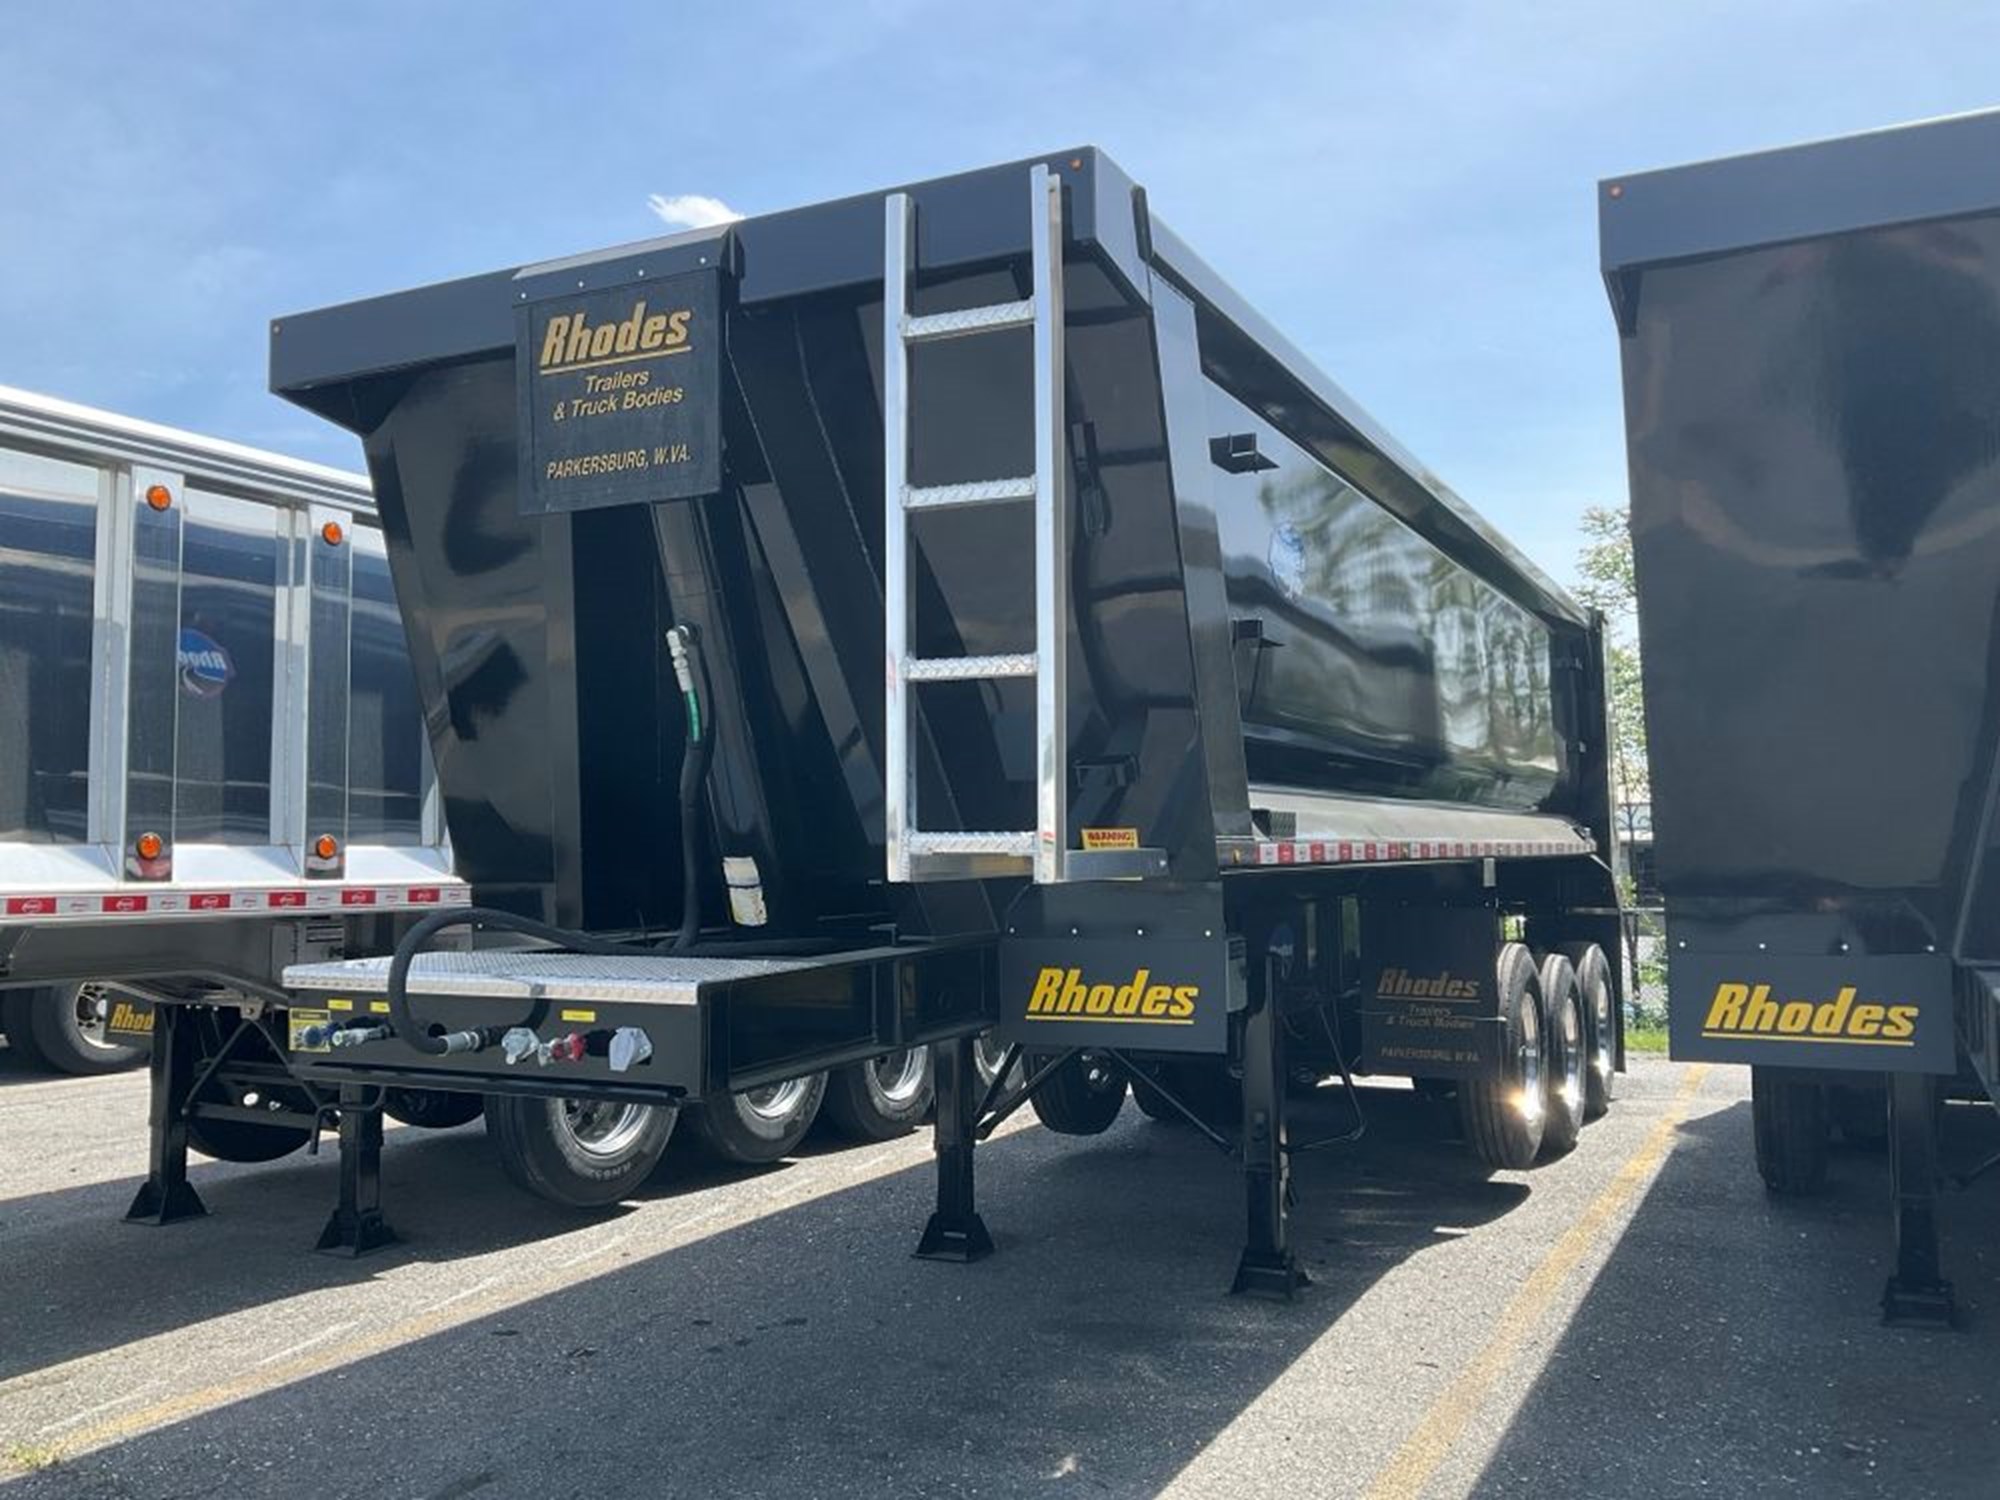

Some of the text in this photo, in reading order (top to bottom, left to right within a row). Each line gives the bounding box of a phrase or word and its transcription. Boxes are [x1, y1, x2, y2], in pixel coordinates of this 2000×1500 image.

[540, 301, 692, 367] Rhodes
[586, 370, 649, 394] Trailers
[553, 386, 683, 421] & Truck Bodies
[547, 443, 691, 479] PARKERSBURG, W.VA.
[1028, 968, 1199, 1017] Rhodes
[1377, 968, 1480, 997] Rhodes
[1703, 983, 1920, 1038] Rhodes
